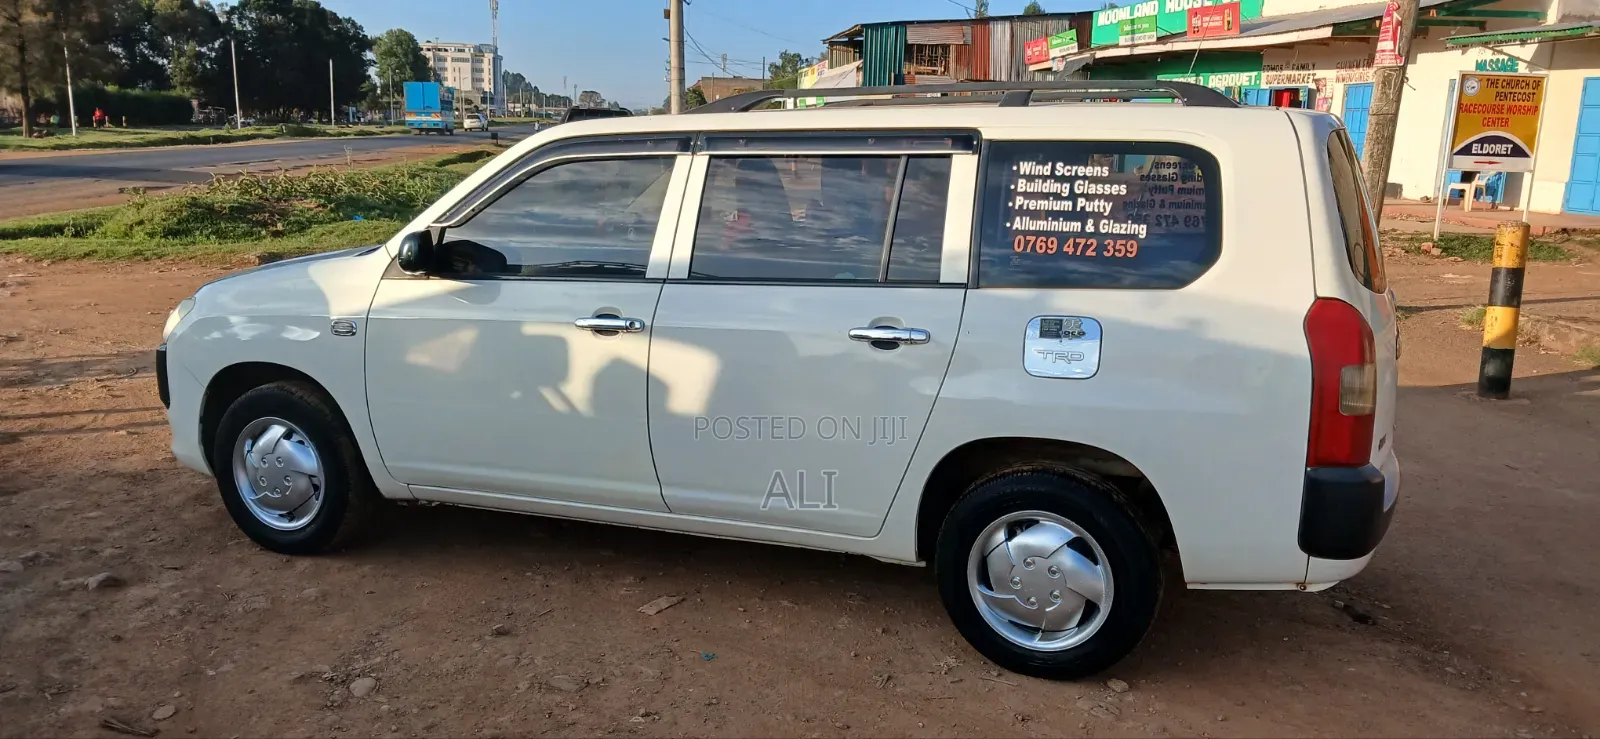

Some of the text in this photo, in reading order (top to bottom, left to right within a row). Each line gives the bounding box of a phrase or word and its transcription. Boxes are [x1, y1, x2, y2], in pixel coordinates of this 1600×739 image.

[1097, 0, 1159, 27] MOONLAND
[1291, 62, 1316, 71] FAMILY
[1475, 57, 1518, 72] MASSAGE
[1266, 73, 1316, 85] SUPERMARKET
[1486, 78, 1541, 90] THE CHURCH OF
[1494, 92, 1536, 102] PENTECOST
[1459, 103, 1538, 115] RACECOURSE WORSHIP
[1482, 117, 1510, 127] CENTER
[1472, 143, 1513, 154] ELDORET
[1019, 161, 1109, 177] Wind Screens
[1017, 178, 1127, 197] Building Glasses
[1015, 196, 1113, 216] Premium Putty
[1013, 216, 1081, 232] Alluminium
[1085, 218, 1095, 233] &
[1099, 219, 1147, 239] Glazing
[1014, 235, 1138, 258] 0769 472 359
[1034, 349, 1084, 364] TRD
